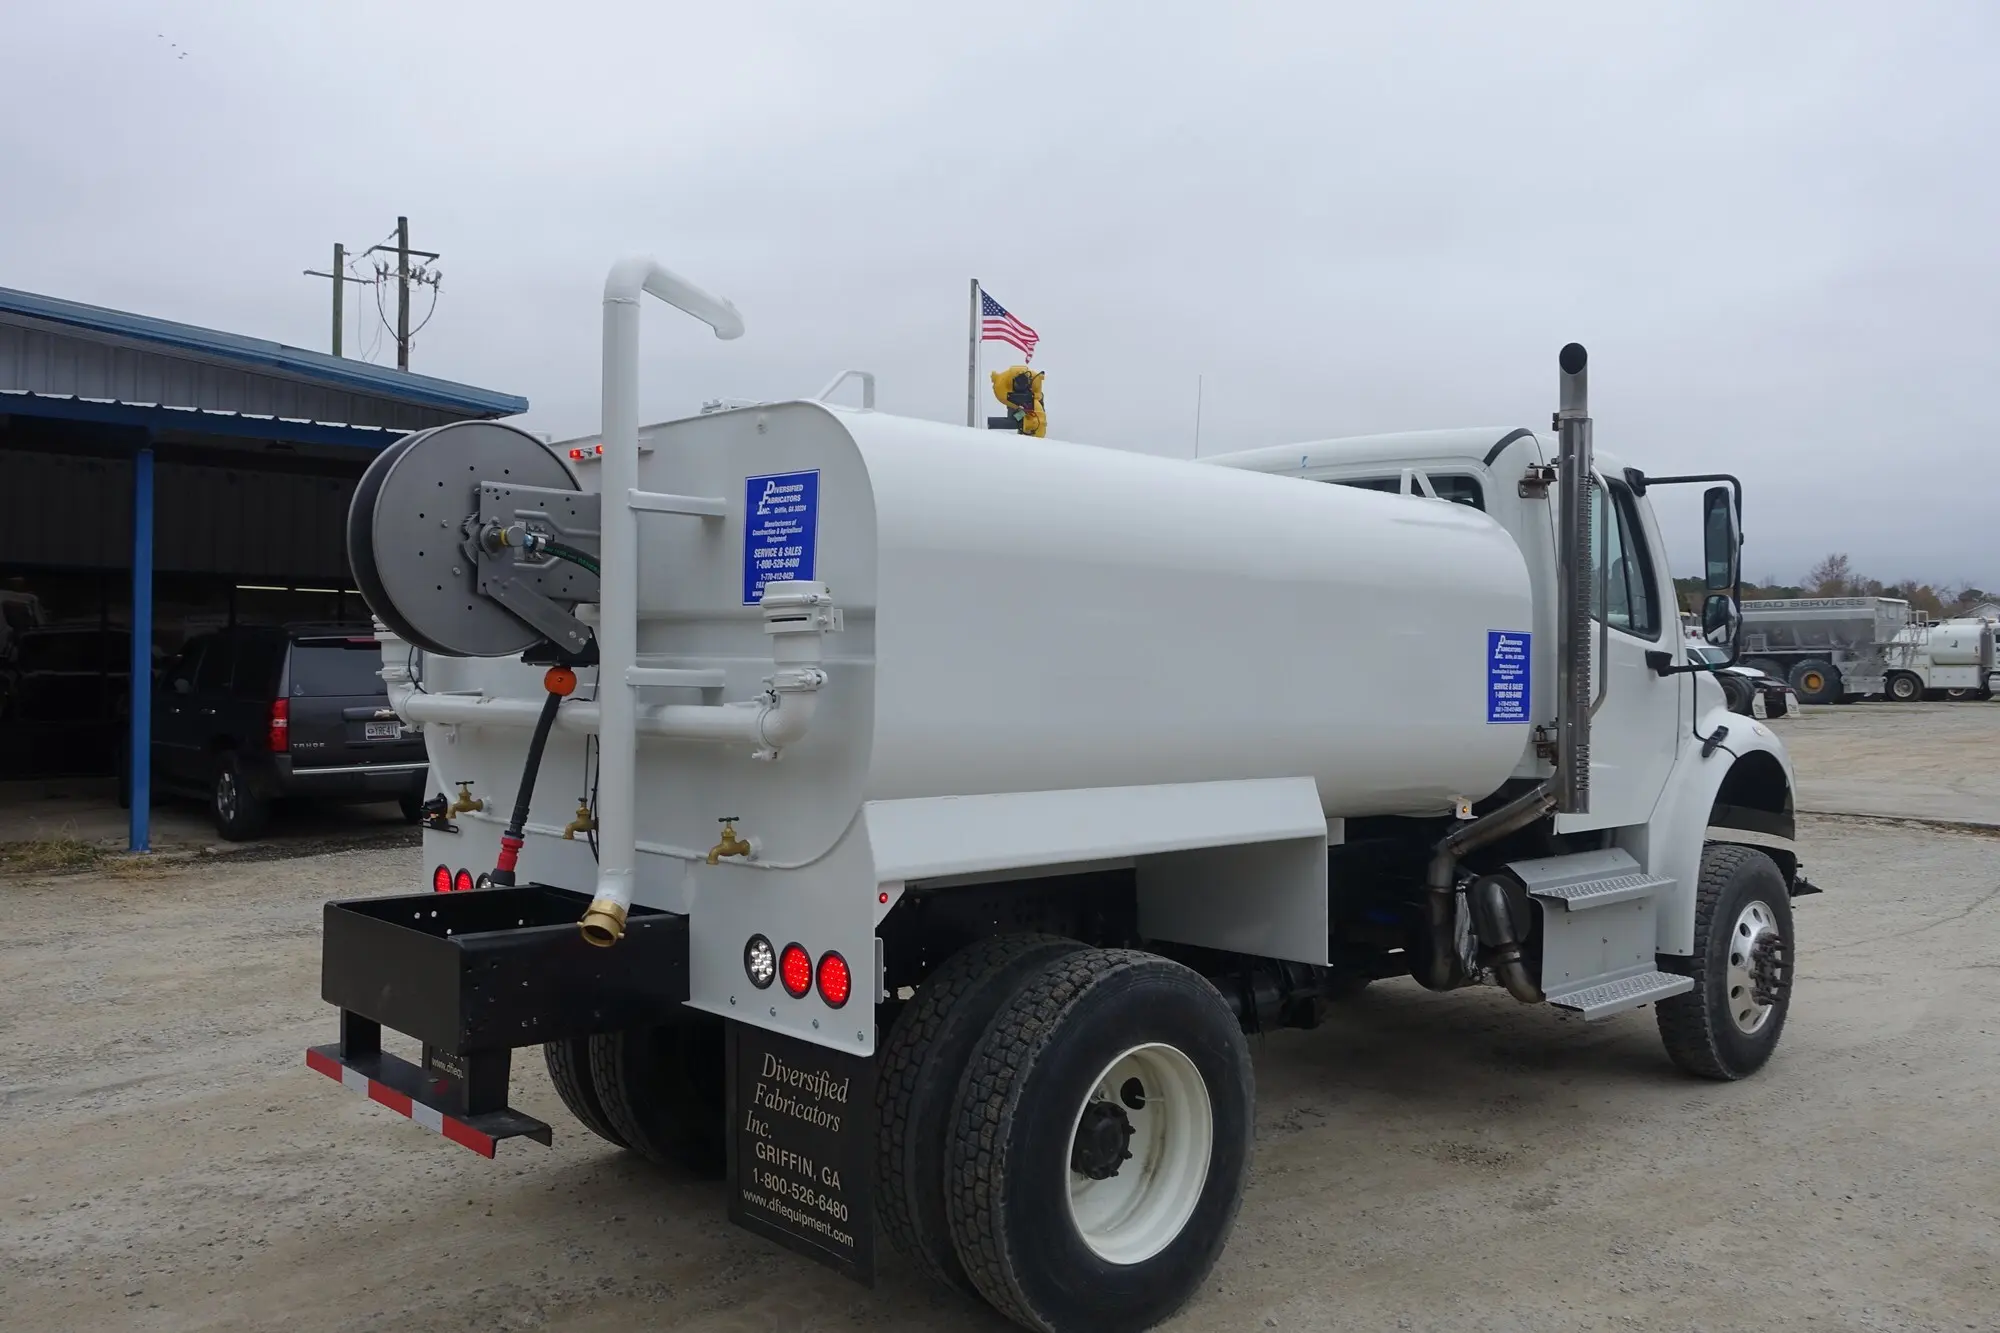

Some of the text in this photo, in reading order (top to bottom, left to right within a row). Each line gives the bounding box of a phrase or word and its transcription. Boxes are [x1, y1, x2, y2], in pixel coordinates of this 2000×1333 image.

[754, 545, 803, 558] SERVICE & SALES
[1790, 598, 1867, 607] SERVICES
[761, 1052, 850, 1104] Diversified
[745, 1109, 772, 1139] Inc.
[754, 1082, 841, 1132] Fabricators
[755, 1141, 842, 1191] GRIFFIN, GA
[743, 1188, 854, 1248] www.dfiequipment.com
[753, 1167, 848, 1223] 1-800-526-6480
